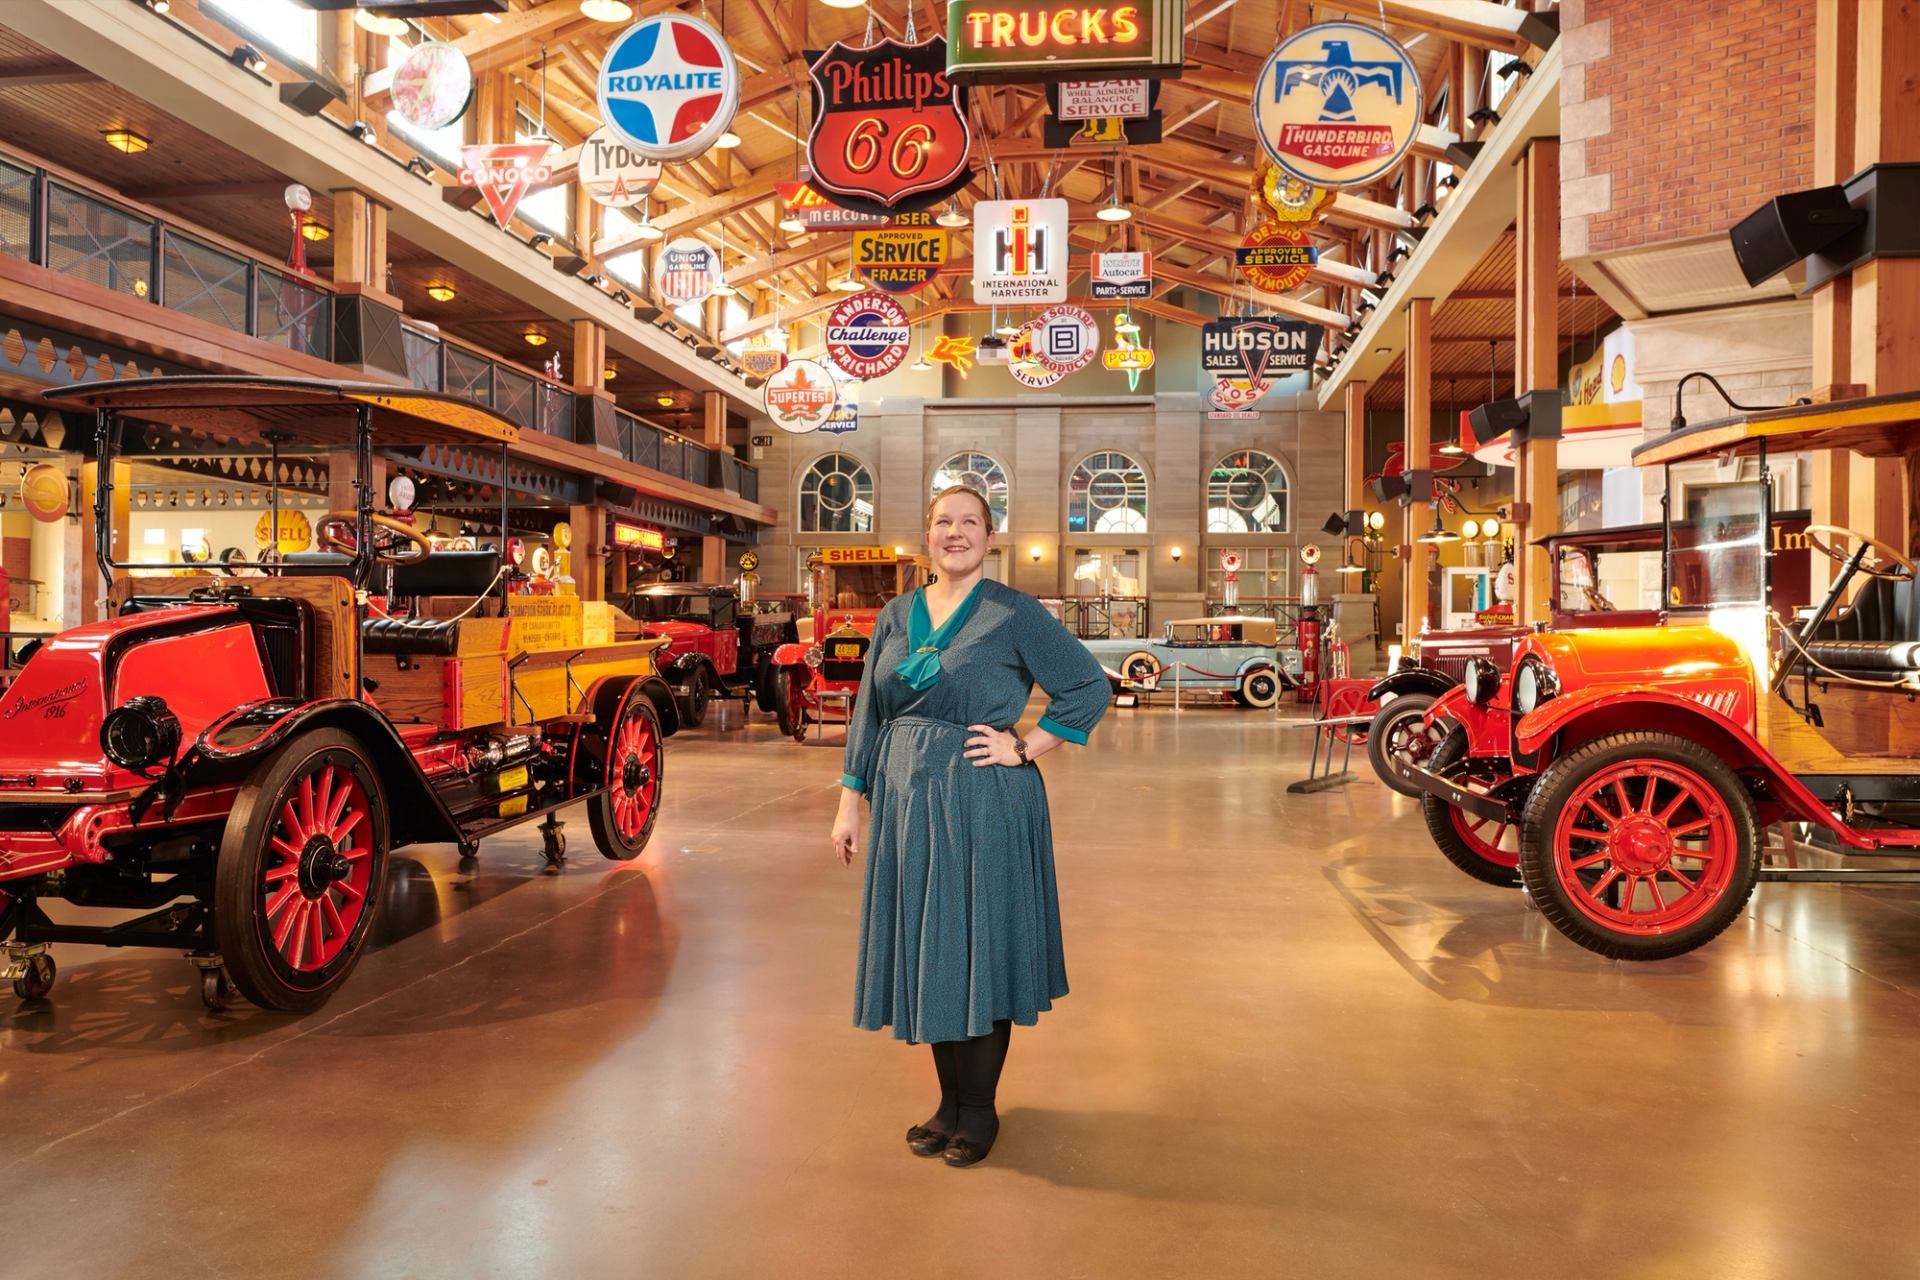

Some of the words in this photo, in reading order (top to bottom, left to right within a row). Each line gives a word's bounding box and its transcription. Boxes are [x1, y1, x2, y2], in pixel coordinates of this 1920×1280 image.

[966, 7, 1139, 48] TRUCKS
[608, 72, 721, 92] ROYALITE
[824, 57, 950, 112] Phillips
[1067, 89, 1092, 97] WHEEL
[1096, 87, 1140, 96] ALINEMENT
[1072, 95, 1134, 105] BALANCING
[1066, 103, 1142, 115] SERVICE
[1285, 125, 1392, 145] THUNDERBIRD
[844, 117, 936, 179] 66
[1303, 144, 1370, 157] GASOLINE
[460, 166, 550, 185] CONOCO
[893, 212, 931, 226] ISER
[878, 232, 923, 240] APPROVED
[860, 237, 941, 262] SERVICE
[1250, 247, 1304, 255] APPROVED
[670, 253, 705, 263] UNION
[1245, 255, 1309, 264] SERVICE
[669, 263, 707, 271] GASOLINE
[1102, 268, 1142, 277] Autocar
[871, 268, 927, 281] FRAZER
[1246, 266, 1307, 290] PLYMOUTH
[982, 278, 1059, 289] INTERNATIONAL
[1095, 286, 1117, 296] PARTS
[1120, 285, 1147, 295] SERVICE
[991, 288, 1049, 297] HARVESTER
[835, 297, 904, 326] ANDERSON
[1034, 314, 1049, 331] BE
[1050, 305, 1095, 330] SQUARE
[829, 328, 907, 344] Challenge
[1205, 331, 1306, 351] HUDSON
[833, 345, 903, 375] PRICHARD
[1035, 348, 1095, 373] PRODUCTS
[1206, 355, 1238, 366] SALES
[1269, 354, 1306, 366] SERVICE
[1218, 377, 1270, 400] ROSE
[770, 390, 829, 404] SUPERTEST
[260, 527, 306, 542] SELL
[830, 549, 890, 561] SHELL
[4, 676, 88, 719] International
[43, 704, 67, 719] 1916
